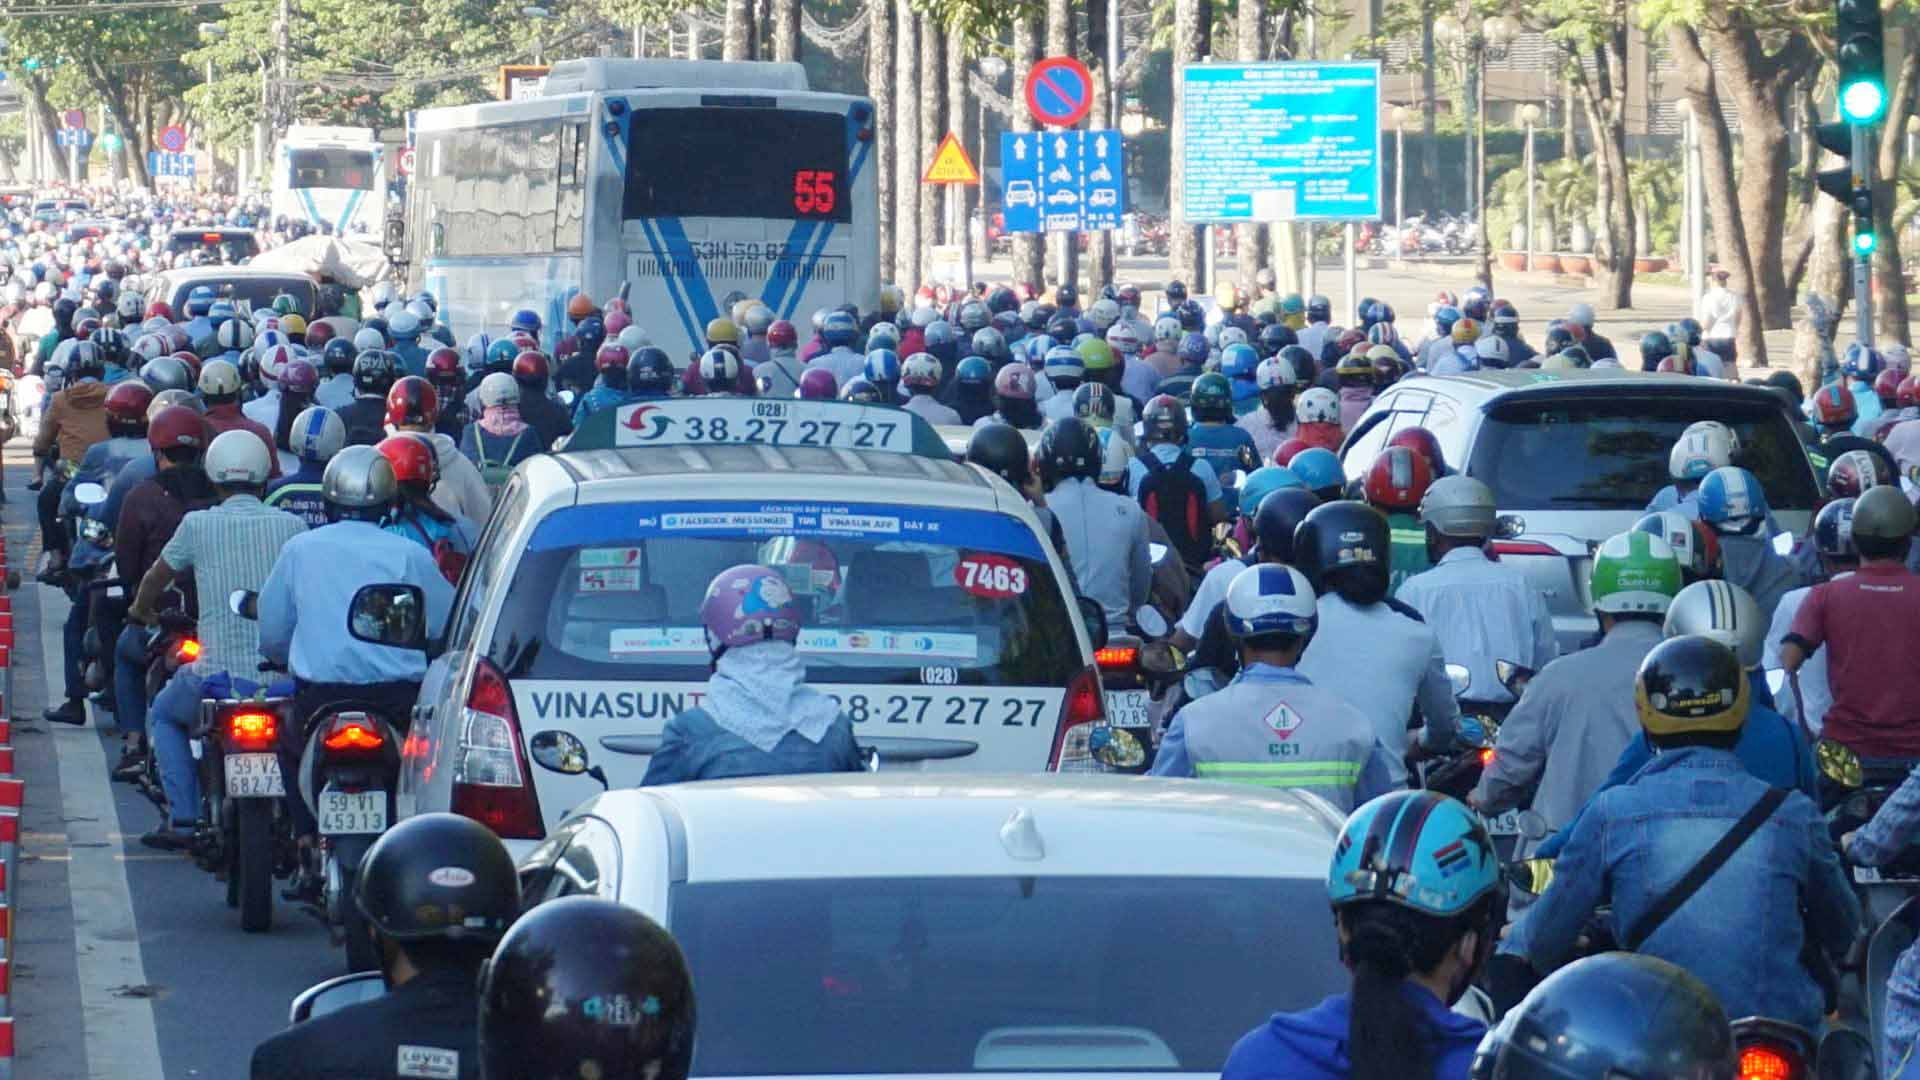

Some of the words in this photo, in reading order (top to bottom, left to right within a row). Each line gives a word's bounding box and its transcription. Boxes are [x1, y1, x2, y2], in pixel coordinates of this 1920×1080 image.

[795, 171, 834, 213] 55
[752, 403, 788, 418] (028)
[685, 416, 788, 446] 38.27
[799, 421, 840, 447] 27
[854, 424, 897, 448] 27
[680, 517, 727, 526] FACEBOOK
[732, 516, 787, 525] MESSENGER
[962, 561, 1025, 593] 7463
[920, 666, 958, 684] (028)
[945, 697, 989, 725] 27
[1002, 698, 1046, 727] 27
[1268, 743, 1300, 756] CC1
[321, 813, 383, 831] 453.13
